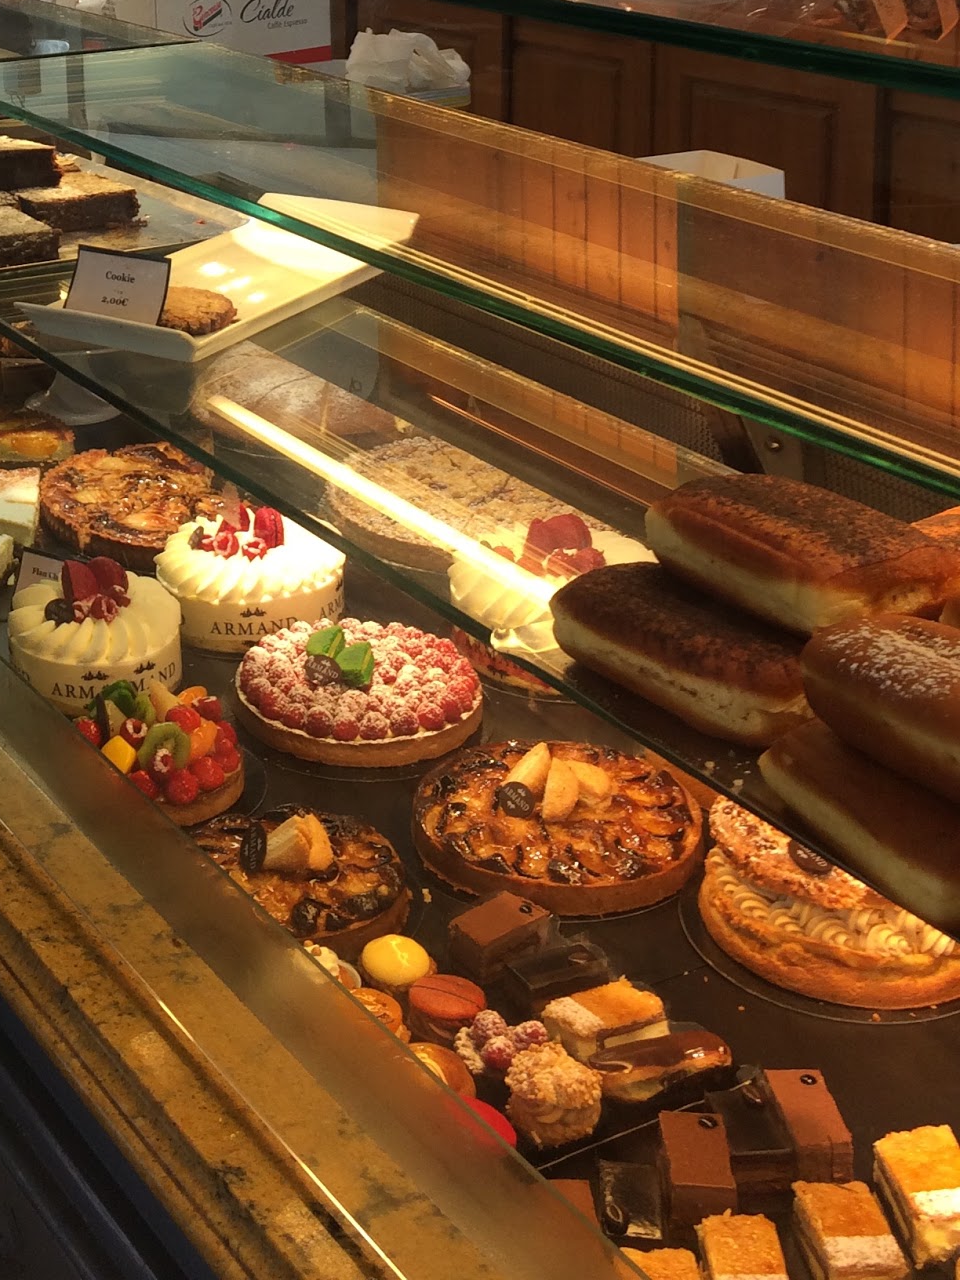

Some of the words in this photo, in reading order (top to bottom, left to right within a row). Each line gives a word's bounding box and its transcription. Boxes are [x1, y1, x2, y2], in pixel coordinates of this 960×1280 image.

[105, 270, 136, 284] Cookie
[100, 296, 130, 307] 2,00€
[31, 567, 48, 578] Flan
[319, 593, 345, 620] ARM
[210, 616, 299, 636] ARMAND
[306, 660, 339, 679] ARMAND
[51, 682, 96, 699] ARM
[503, 786, 530, 812] ARMAND
